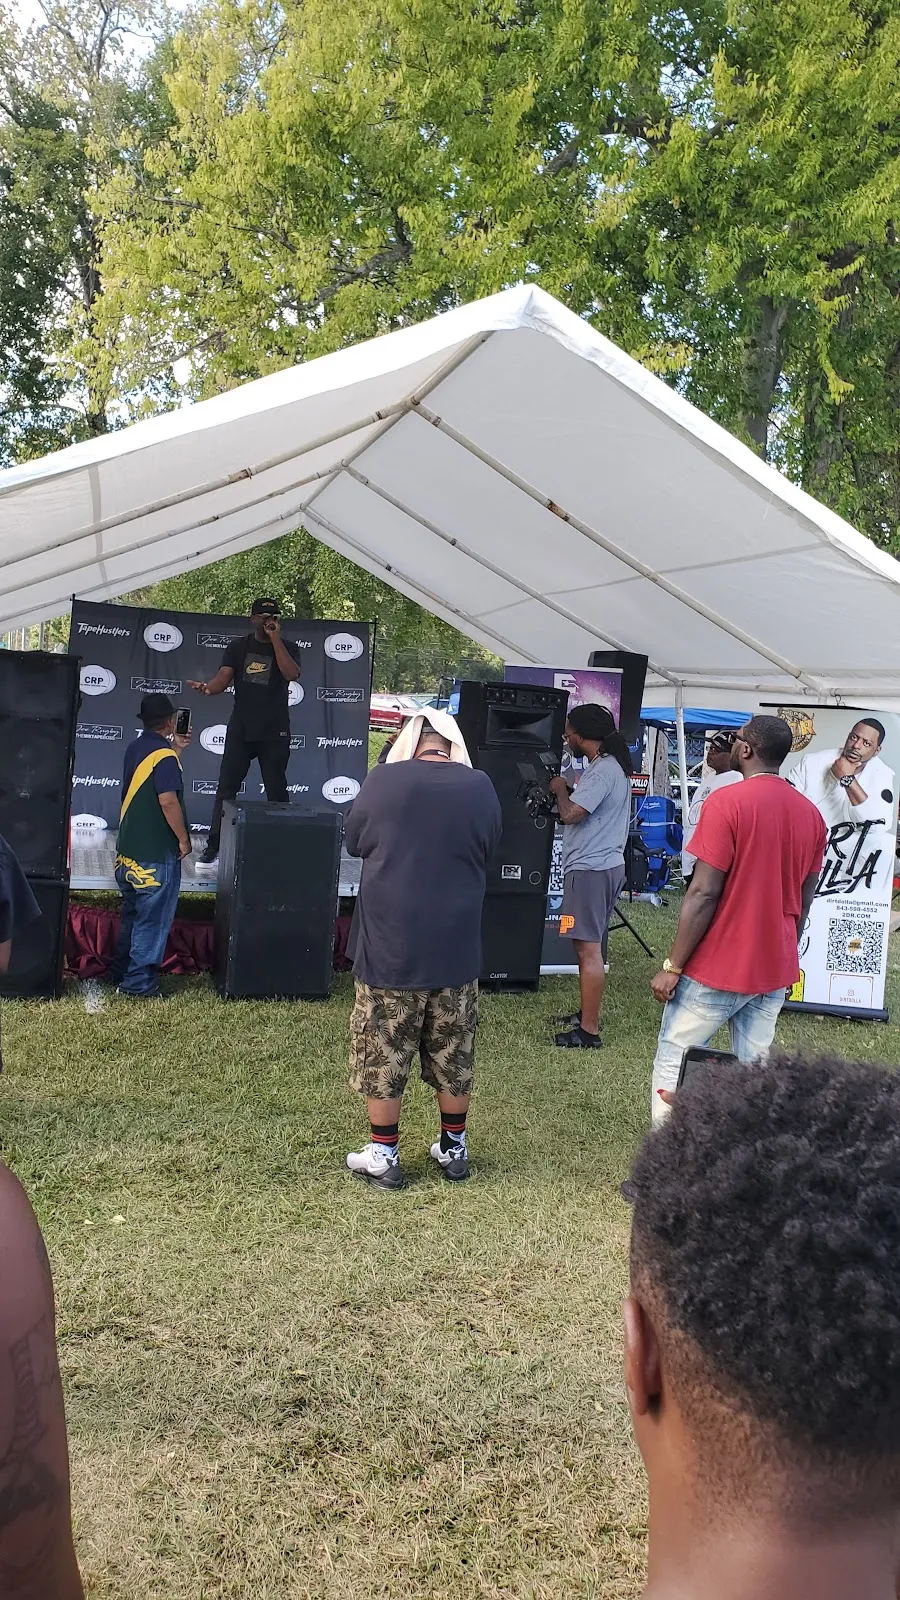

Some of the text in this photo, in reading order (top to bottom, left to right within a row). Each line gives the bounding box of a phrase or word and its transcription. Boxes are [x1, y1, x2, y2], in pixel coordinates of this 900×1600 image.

[153, 633, 172, 642] CRP
[335, 643, 353, 651] CRP
[250, 661, 266, 670] NIKE
[84, 676, 104, 685] CRP
[212, 736, 225, 744] CR
